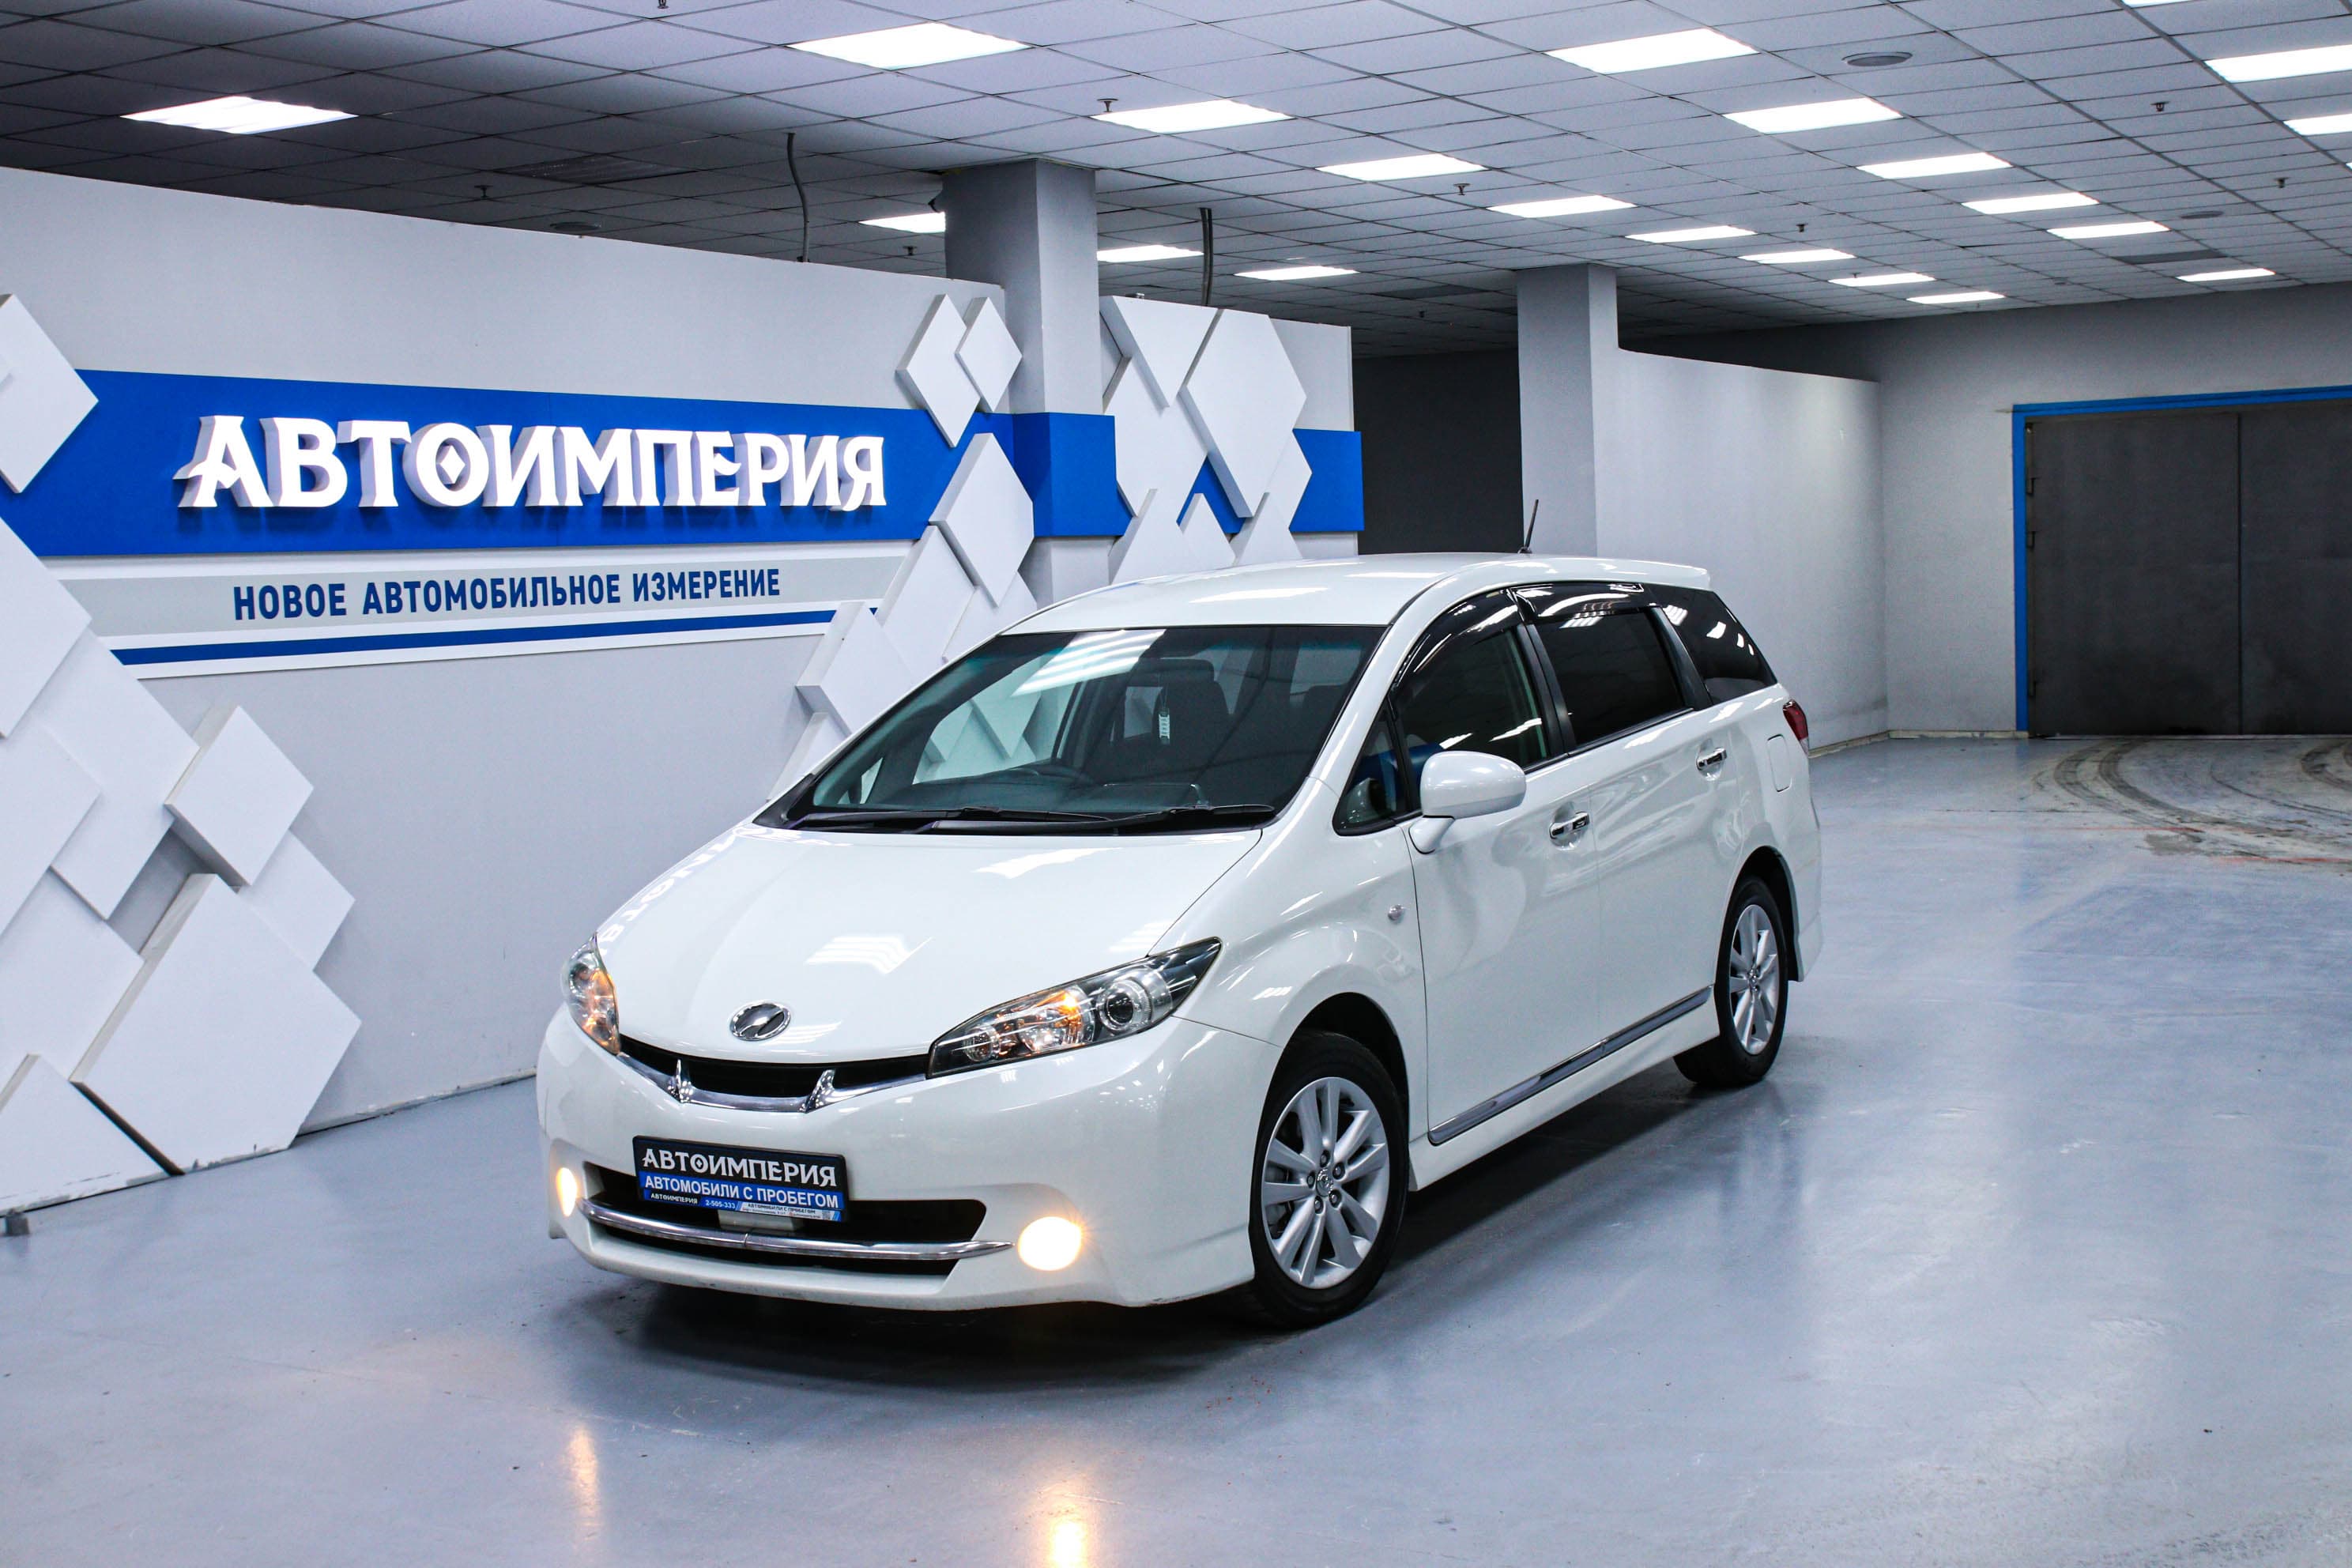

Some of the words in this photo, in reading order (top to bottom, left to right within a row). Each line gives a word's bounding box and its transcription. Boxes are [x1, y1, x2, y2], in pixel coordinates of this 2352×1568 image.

[174, 414, 888, 512] АВТОИМПЕРИЯ
[234, 583, 346, 620] НОВОЕ
[363, 574, 620, 614] АВТОМОБИЛЬНОЕ
[633, 568, 780, 602] ИЗМЕРЕНИЕ
[643, 1148, 836, 1186] АВТОИМПЕРИЯ
[645, 1175, 740, 1199] АВТОМОБИЛИ
[743, 1186, 753, 1200] С
[757, 1188, 839, 1208] ПРОБЕГОМ
[650, 1193, 698, 1204] АВТОИМПЕРИЯ
